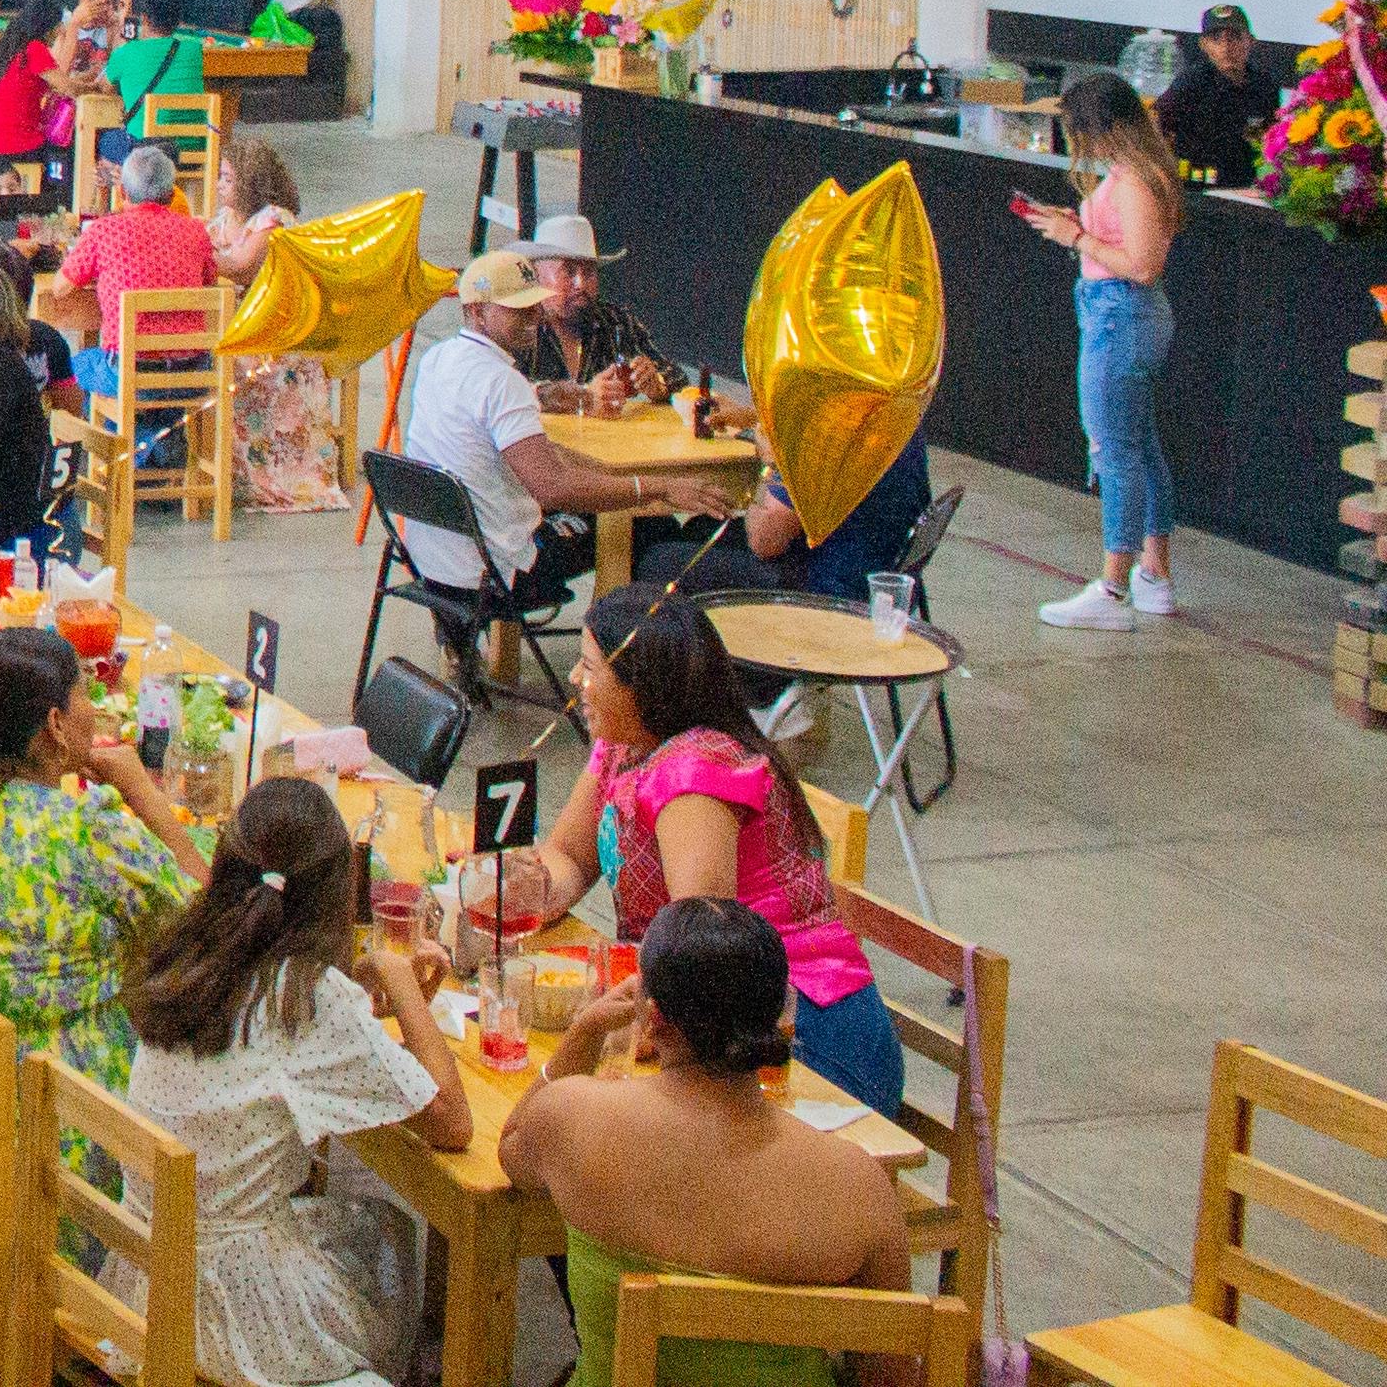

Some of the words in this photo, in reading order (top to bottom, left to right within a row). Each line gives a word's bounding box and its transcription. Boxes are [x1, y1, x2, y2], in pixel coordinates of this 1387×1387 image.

[51, 447, 72, 489] 5
[253, 627, 268, 678] 2
[487, 781, 526, 844] 7
